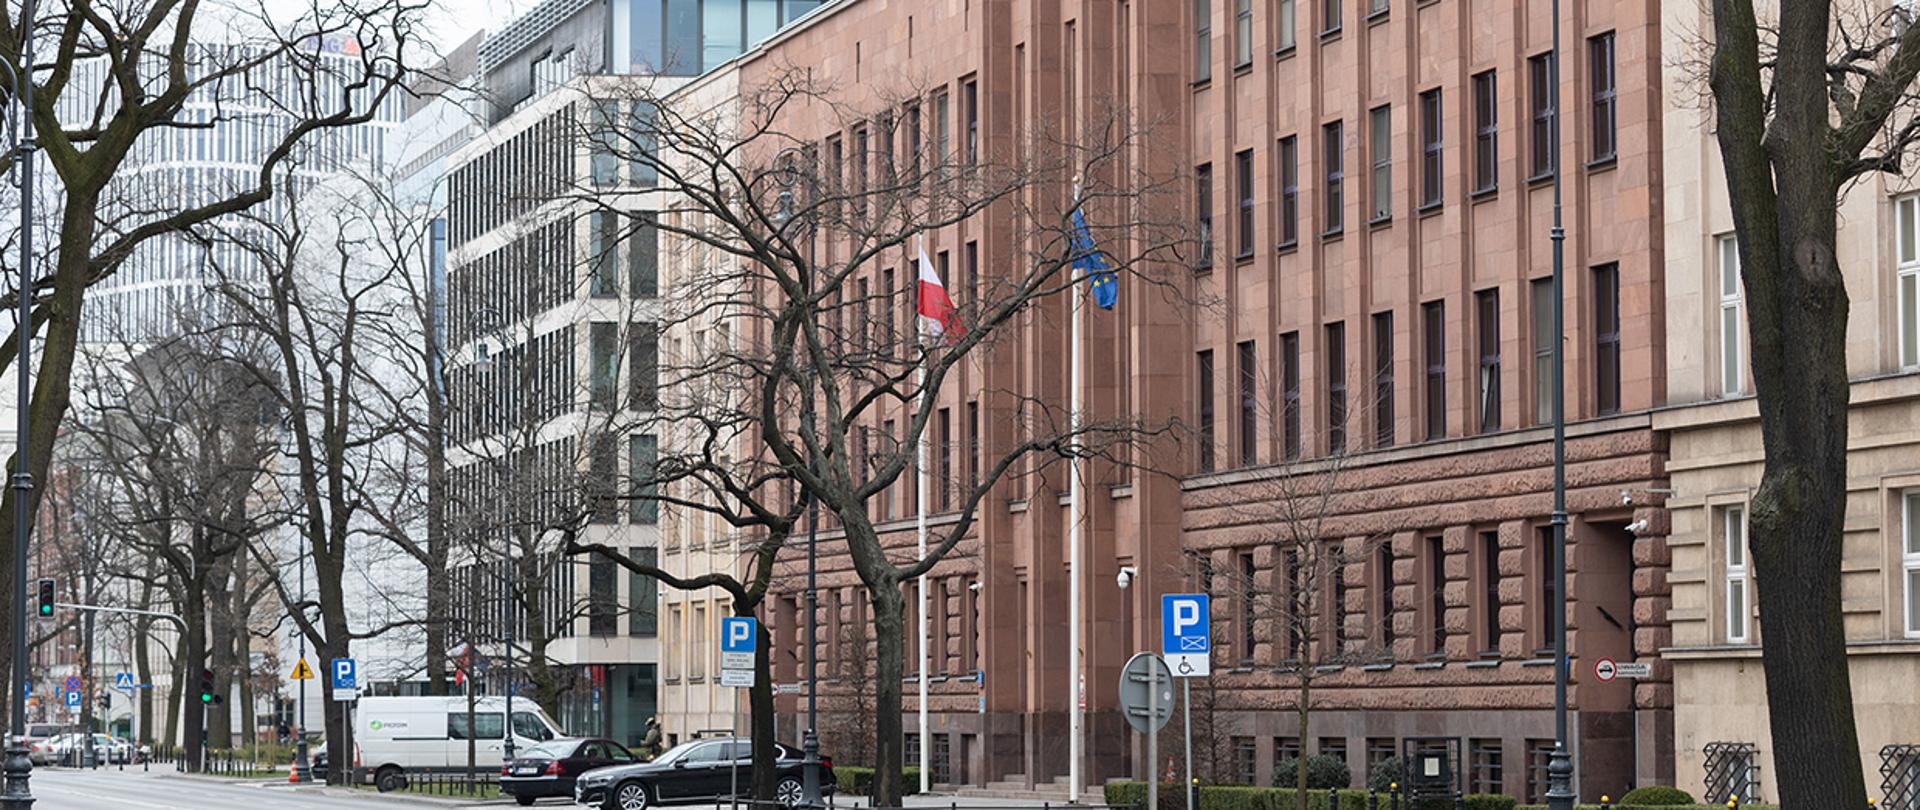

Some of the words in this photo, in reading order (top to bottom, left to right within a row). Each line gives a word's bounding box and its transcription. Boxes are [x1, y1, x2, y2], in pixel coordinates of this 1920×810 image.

[1173, 600, 1199, 636] P
[729, 621, 749, 648] P
[338, 661, 351, 680] P
[68, 691, 78, 704] P
